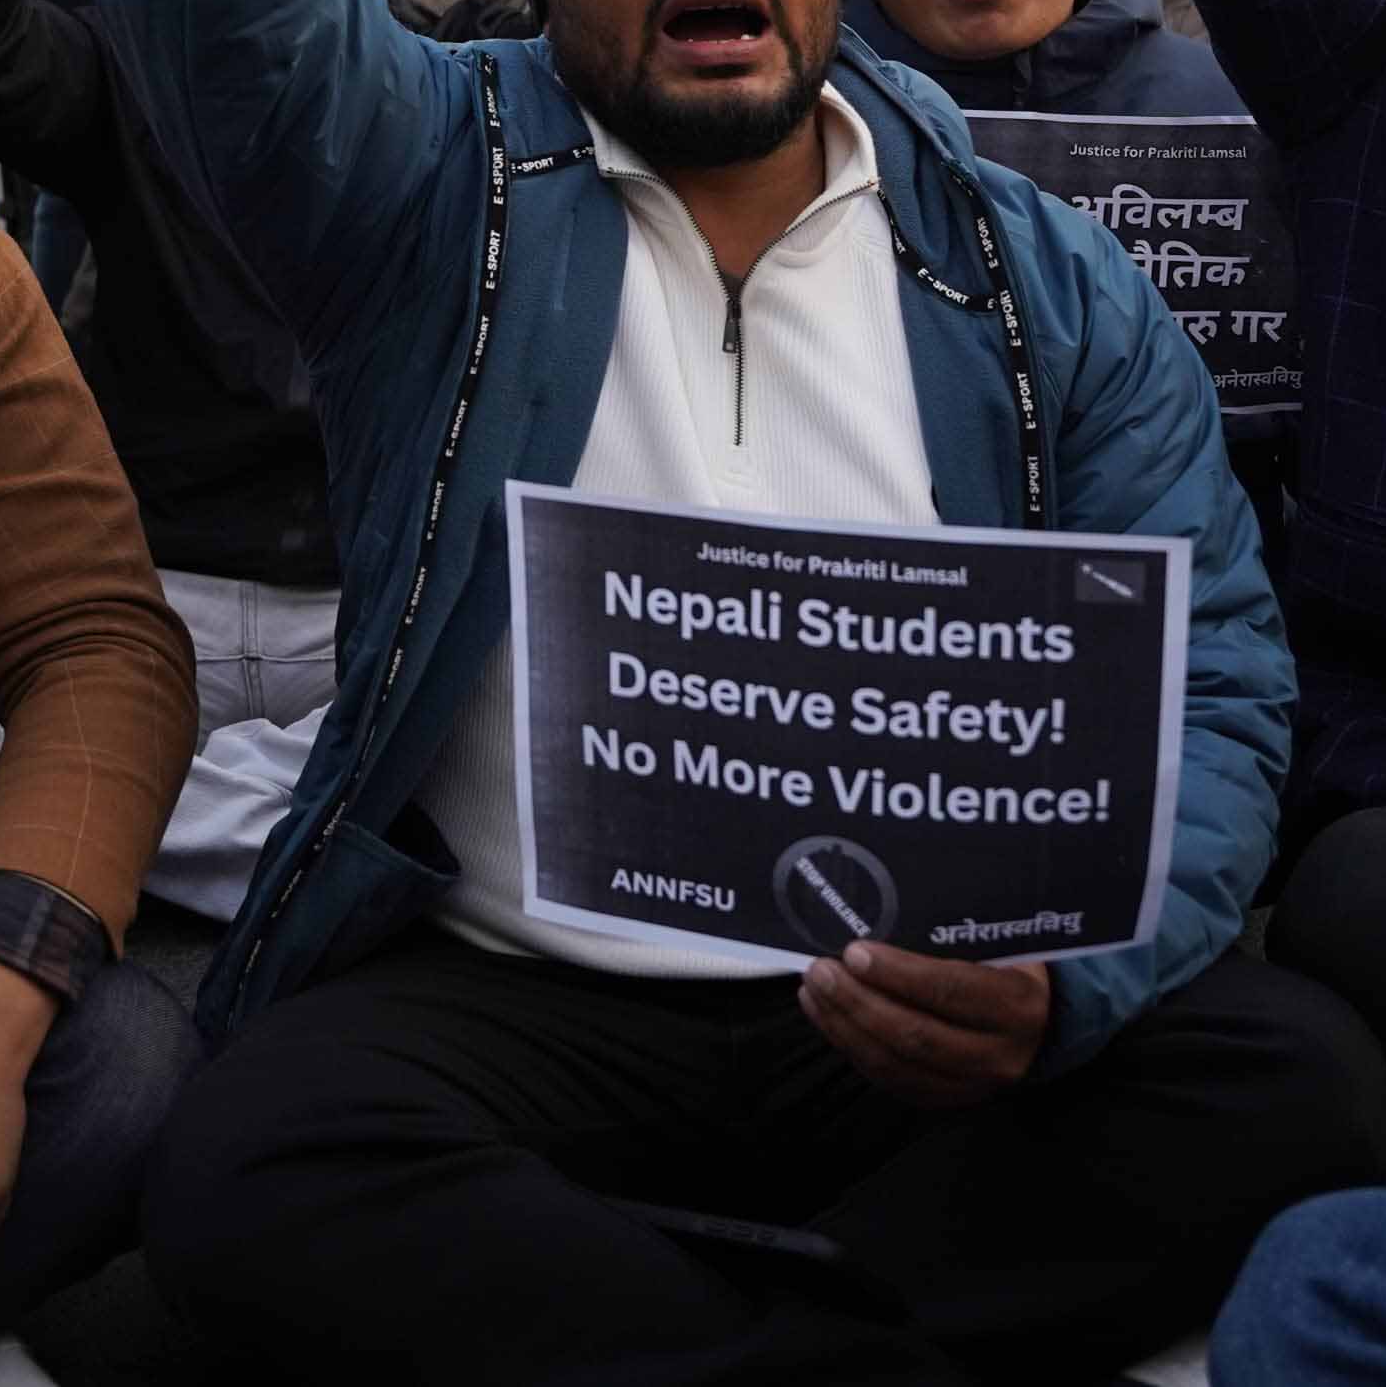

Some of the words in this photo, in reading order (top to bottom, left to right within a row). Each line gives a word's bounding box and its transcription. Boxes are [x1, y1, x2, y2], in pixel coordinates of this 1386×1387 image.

[1069, 143, 1120, 158] Justice
[1123, 145, 1145, 159] for
[1147, 146, 1198, 159] Prakriti
[1200, 146, 1247, 159] Lamsal
[1230, 311, 1287, 343] गर
[697, 542, 770, 571] Justice
[773, 550, 805, 572] for
[808, 555, 886, 582] Prakriti
[892, 562, 968, 587] Lamsal
[605, 571, 782, 643] Nepali
[798, 600, 1075, 663] Students
[609, 653, 835, 731] Deserve
[851, 687, 1066, 757] Safety!
[583, 725, 657, 777] No
[673, 739, 813, 806] More
[828, 766, 1111, 824] Violence!
[611, 868, 735, 912] ANNFSU
